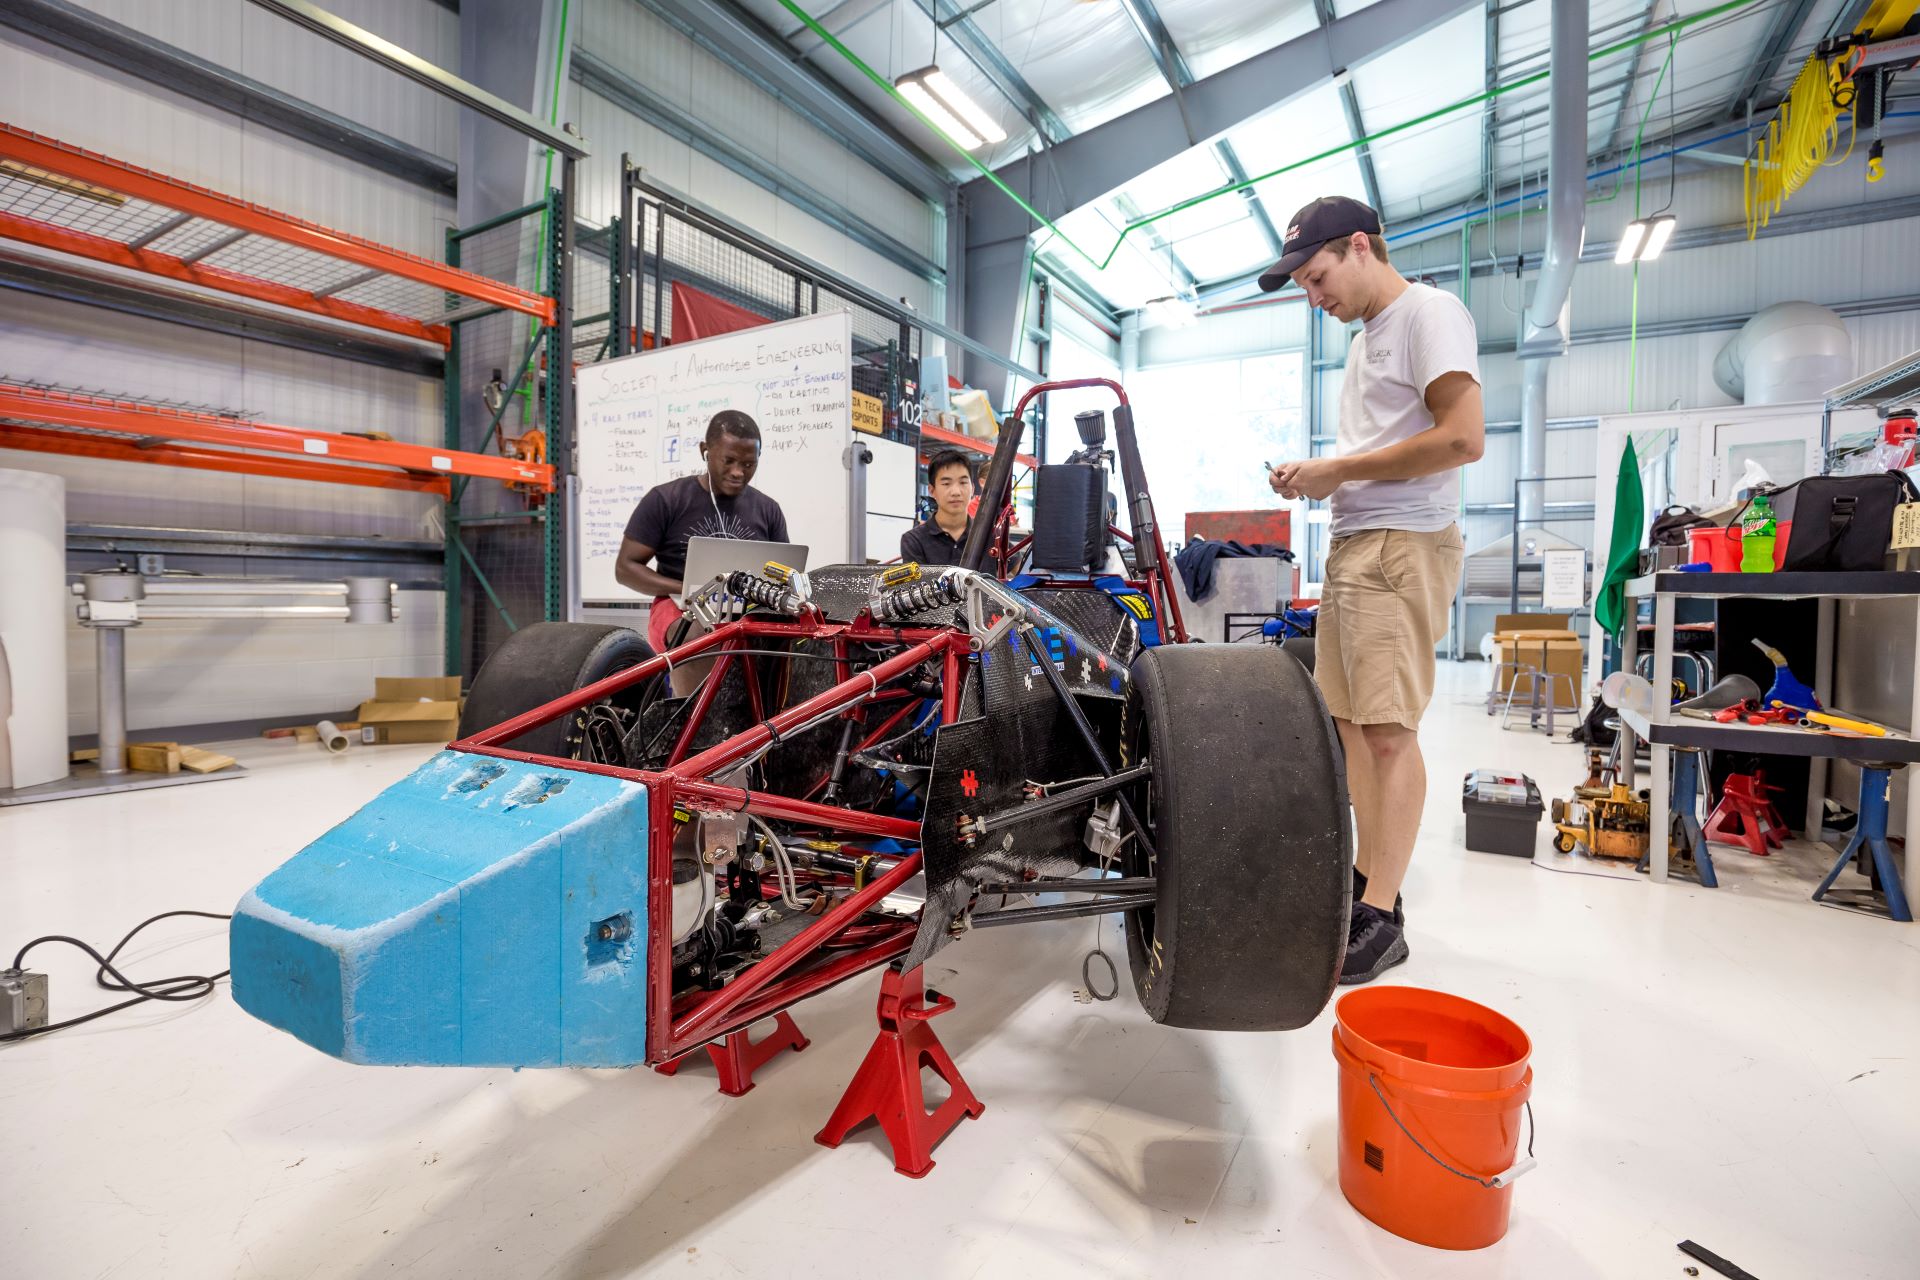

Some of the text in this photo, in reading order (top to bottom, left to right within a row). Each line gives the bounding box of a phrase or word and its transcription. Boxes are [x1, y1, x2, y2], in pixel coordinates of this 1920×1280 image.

[773, 407, 801, 417] DRIVER
[864, 400, 880, 414] TECH
[899, 398, 922, 426] 102
